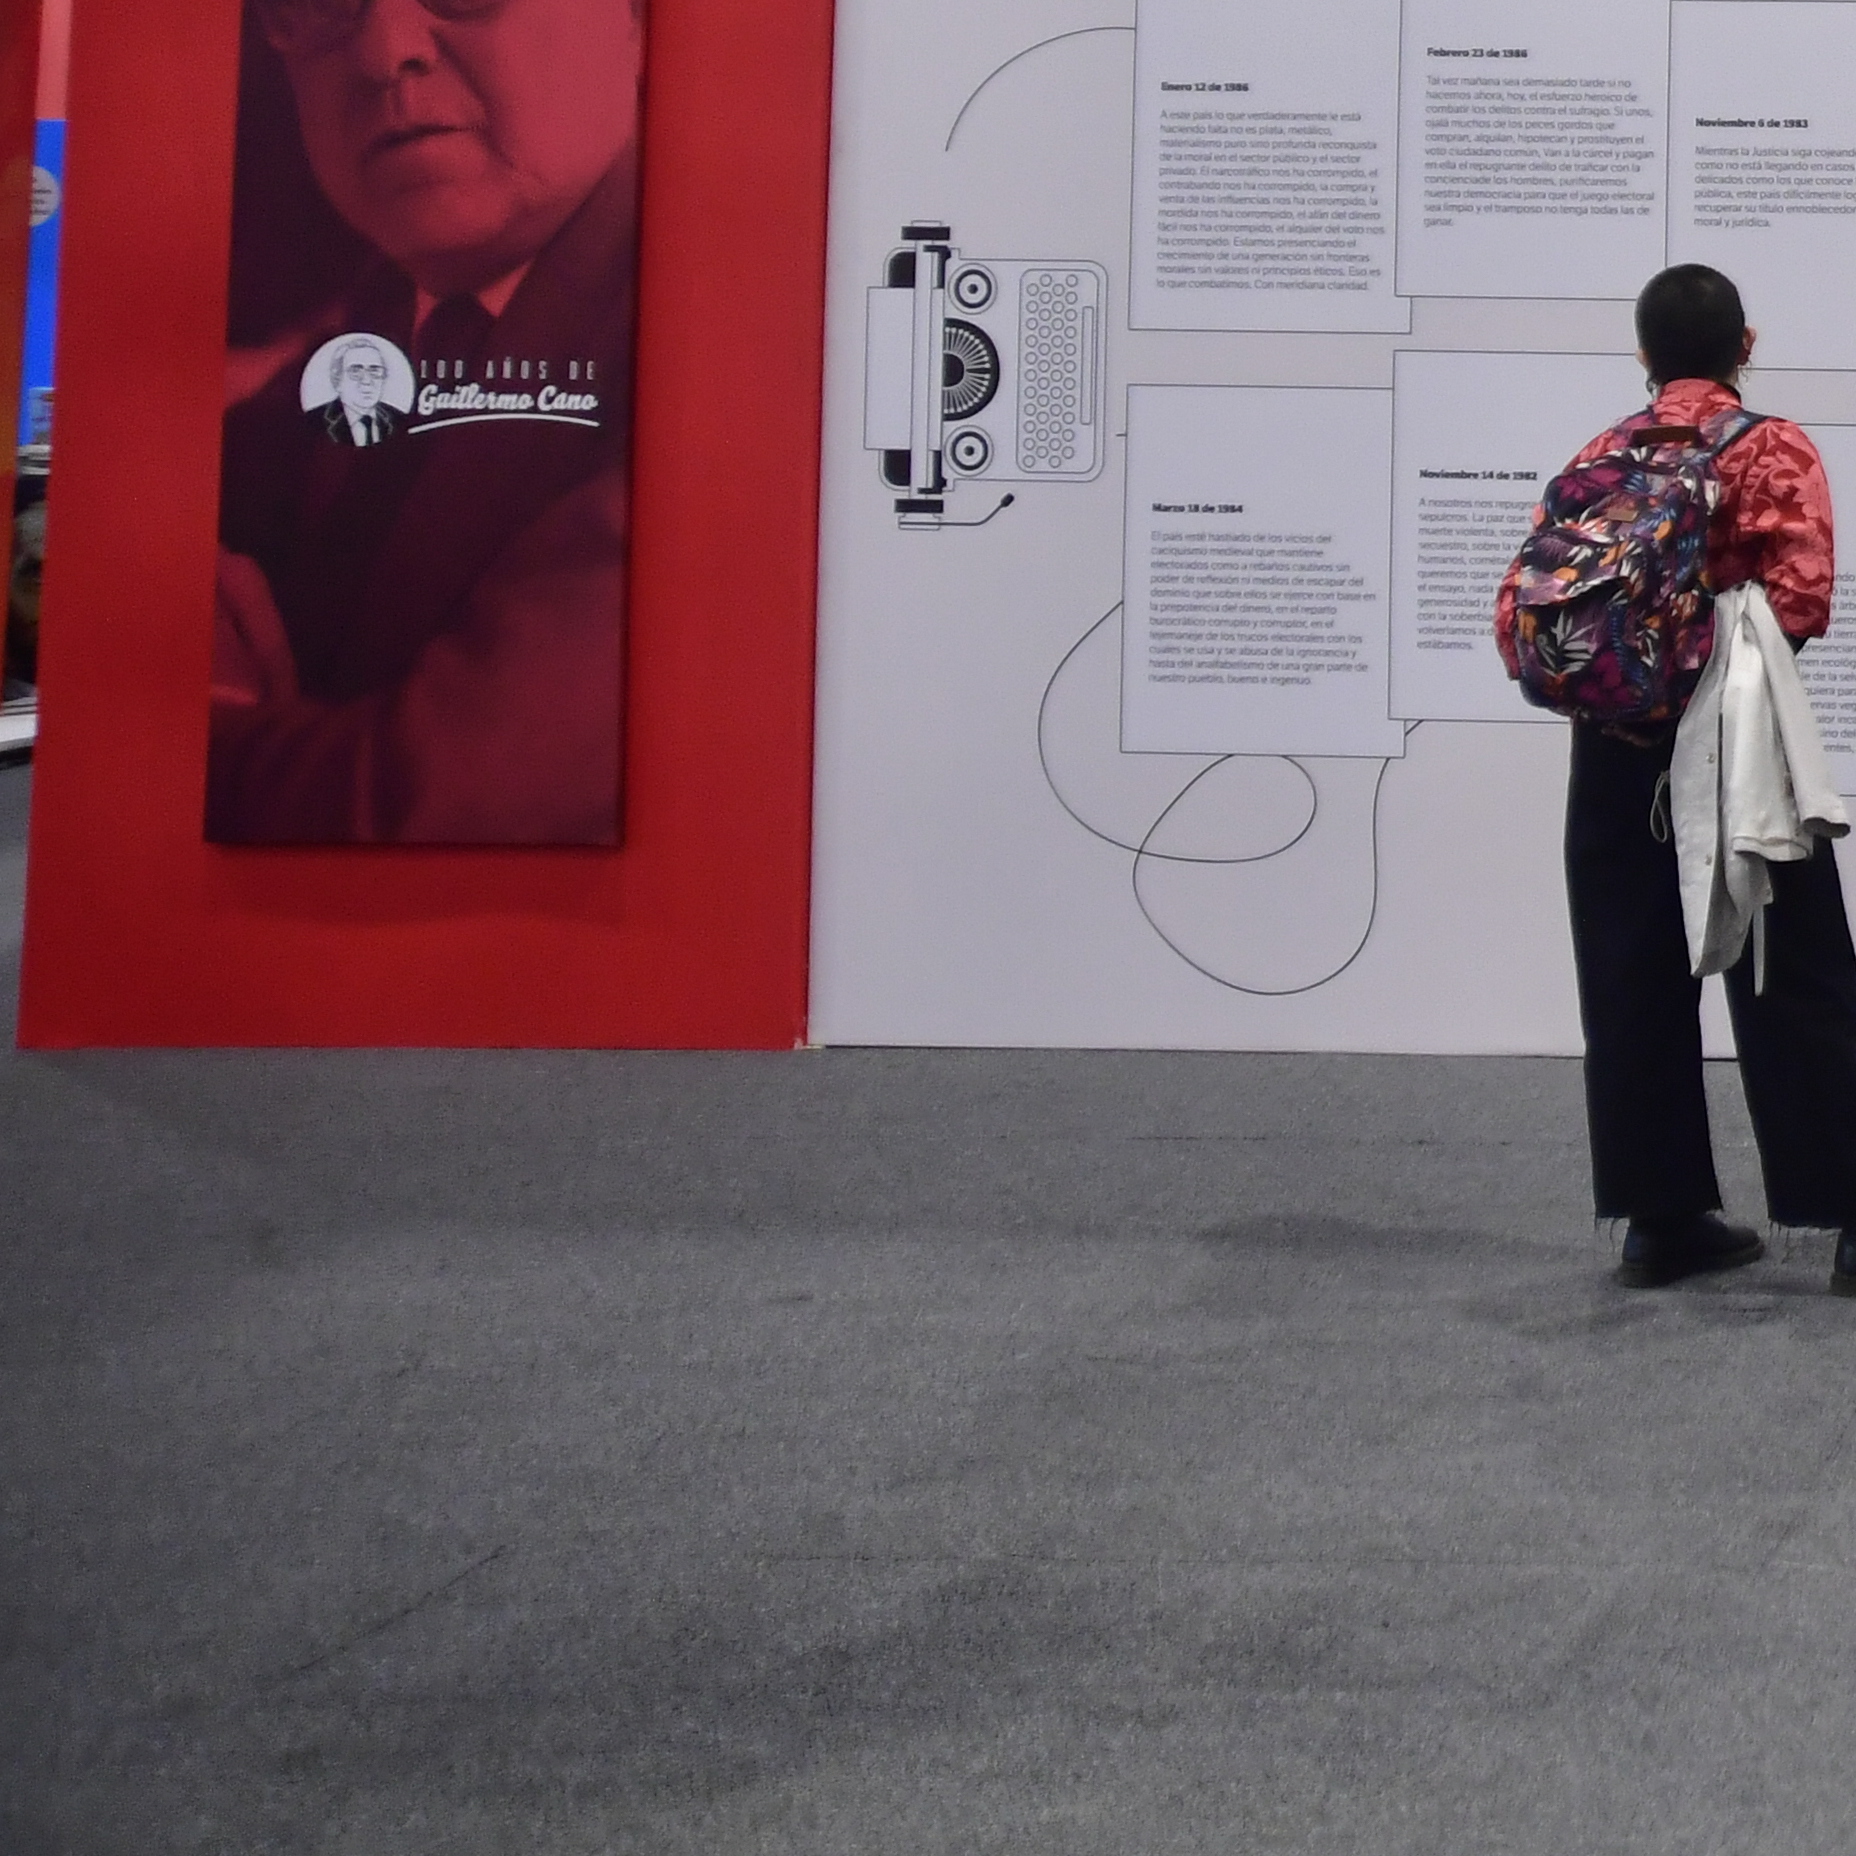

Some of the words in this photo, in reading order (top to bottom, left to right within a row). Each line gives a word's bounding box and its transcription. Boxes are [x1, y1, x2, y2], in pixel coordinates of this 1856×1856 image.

[1427, 47, 1469, 57] Febrero
[1486, 49, 1500, 57] de
[1161, 82, 1192, 91] Enero
[1194, 82, 1206, 91] 12
[1207, 83, 1221, 91] de
[1696, 118, 1756, 127] Noviembre
[1758, 119, 1764, 127] 6
[1766, 118, 1780, 127] de
[420, 359, 463, 379] 100
[486, 356, 547, 380] AÑOS
[569, 360, 595, 380] DE
[418, 382, 534, 415] Guillermo
[537, 385, 598, 411] Cano
[1419, 469, 1478, 479] Noviembre
[1481, 471, 1494, 479] 14
[1496, 471, 1510, 479] de
[1152, 503, 1185, 512] Marzo
[1201, 504, 1215, 513] de
